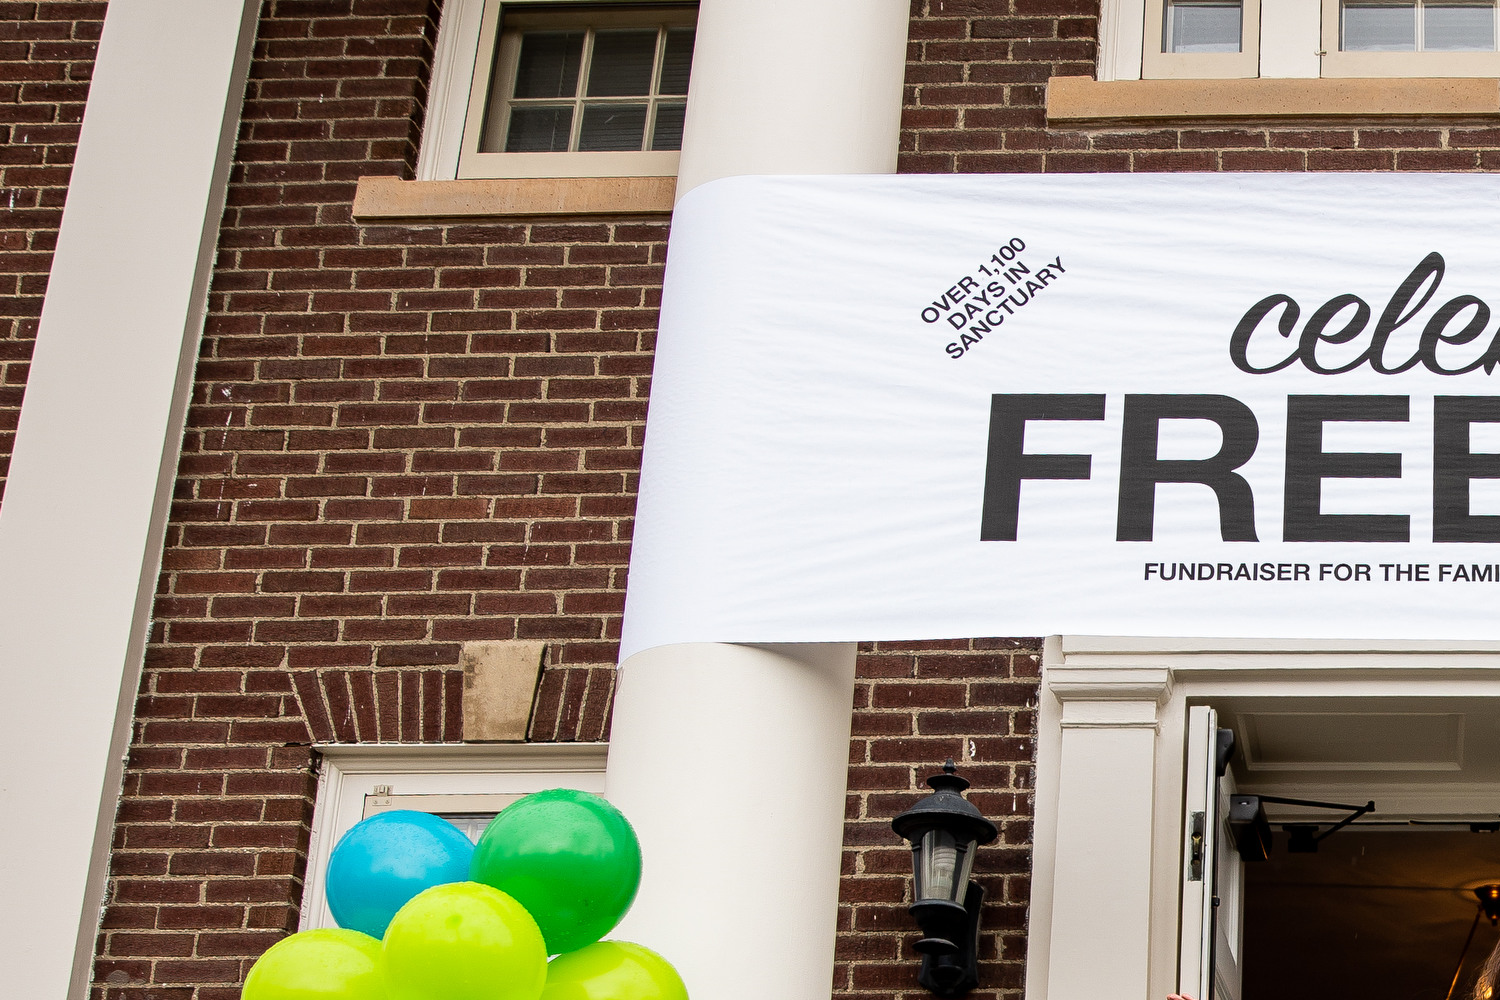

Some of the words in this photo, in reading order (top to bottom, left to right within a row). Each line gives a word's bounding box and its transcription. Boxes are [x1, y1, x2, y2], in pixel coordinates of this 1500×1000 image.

[920, 276, 980, 324] OVER
[978, 237, 1026, 277] 1,100
[945, 255, 1066, 360] SANCTUARY
[946, 281, 1006, 331] DAYS
[1002, 260, 1031, 285] IN
[1144, 562, 1311, 582] FUNDRAISER
[1319, 563, 1371, 582] FOR
[1378, 563, 1430, 582] THE
